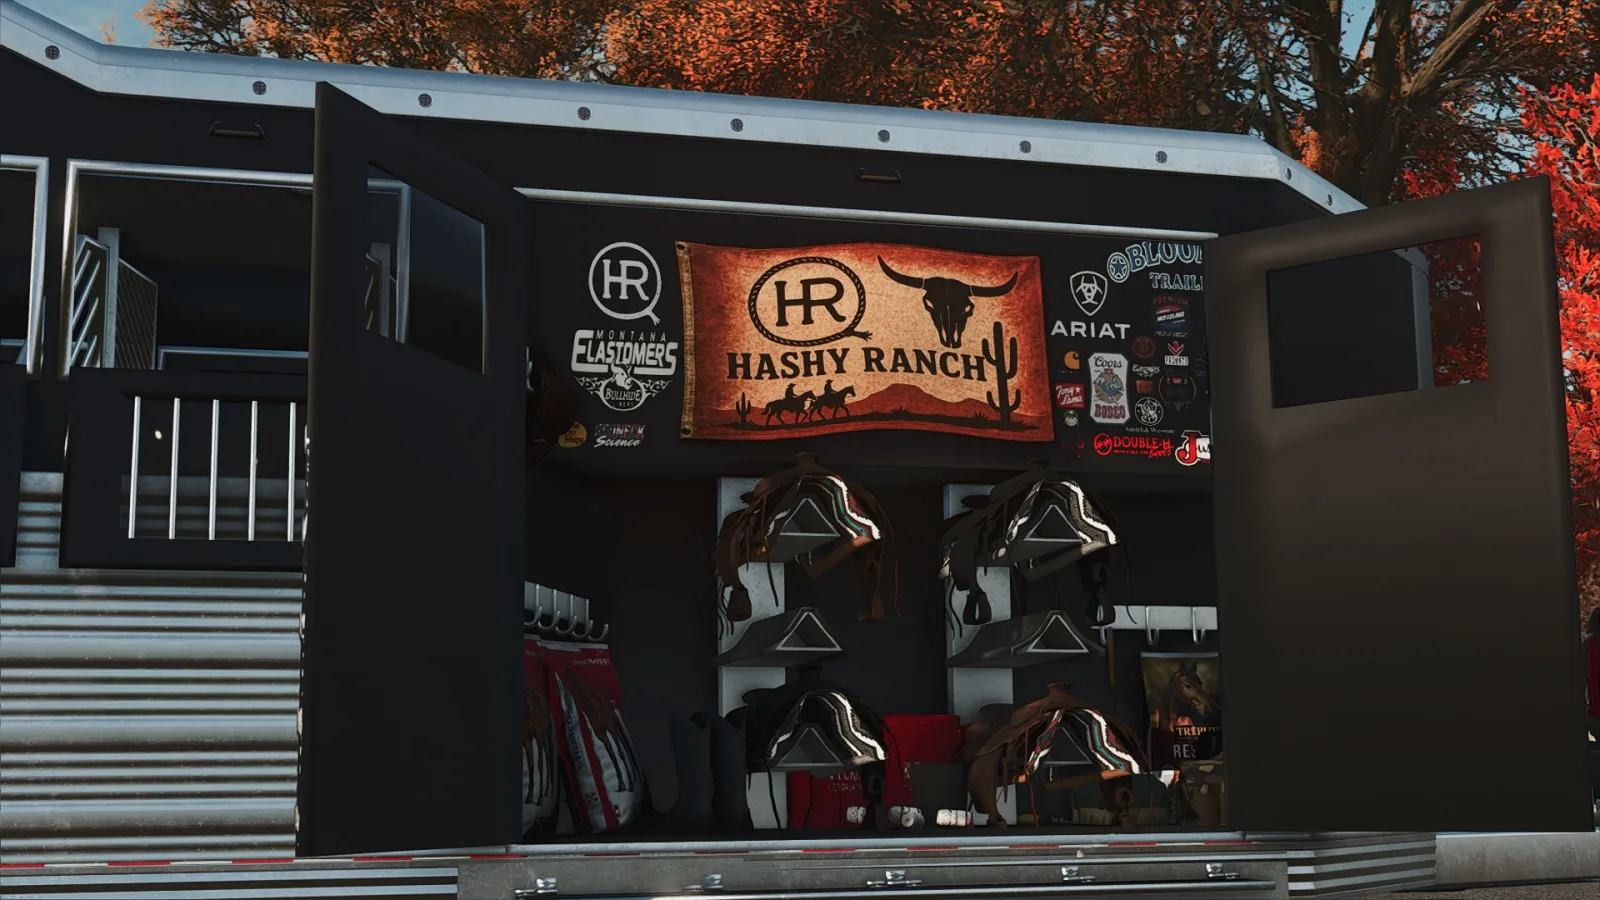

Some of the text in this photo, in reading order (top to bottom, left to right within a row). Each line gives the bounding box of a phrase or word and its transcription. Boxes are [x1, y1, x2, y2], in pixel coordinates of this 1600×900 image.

[602, 259, 650, 300] HR
[1149, 272, 1203, 291] TRAIL
[776, 276, 847, 327] HR
[596, 329, 666, 342] MONTANA
[1050, 320, 1131, 340] ARIAT
[571, 329, 678, 375] ELASTOMERS
[1094, 355, 1122, 368] Coors
[726, 347, 988, 382] HASHY RANCH
[1094, 404, 1126, 419] RODEO
[593, 435, 642, 447] Science
[1113, 435, 1173, 450] DOUBLE-H
